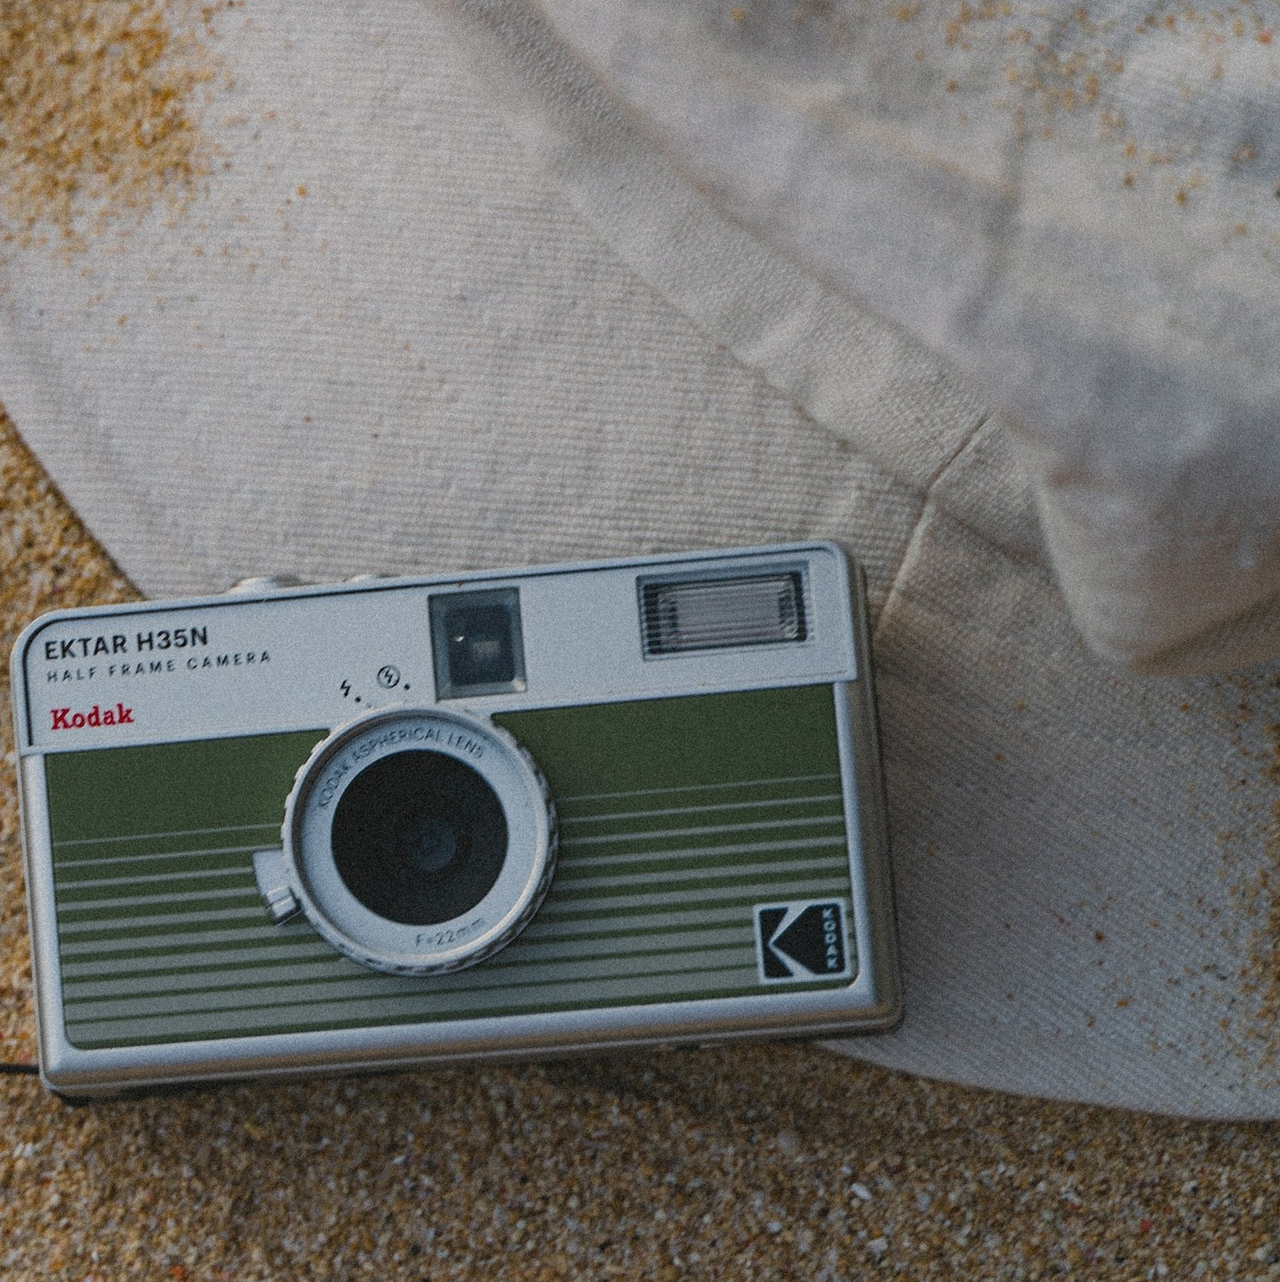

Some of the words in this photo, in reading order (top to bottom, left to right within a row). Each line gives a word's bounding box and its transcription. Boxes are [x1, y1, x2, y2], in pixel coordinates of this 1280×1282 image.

[44, 633, 128, 661] EKTAR
[136, 626, 210, 654] H35N
[46, 665, 98, 684] HALF
[108, 658, 176, 677] FRAME
[186, 650, 271, 671] CAMERA
[50, 703, 135, 731] Kodak
[318, 761, 352, 811] KODAK
[352, 728, 443, 763] ASPHERICAL
[823, 908, 837, 969] KODAK
